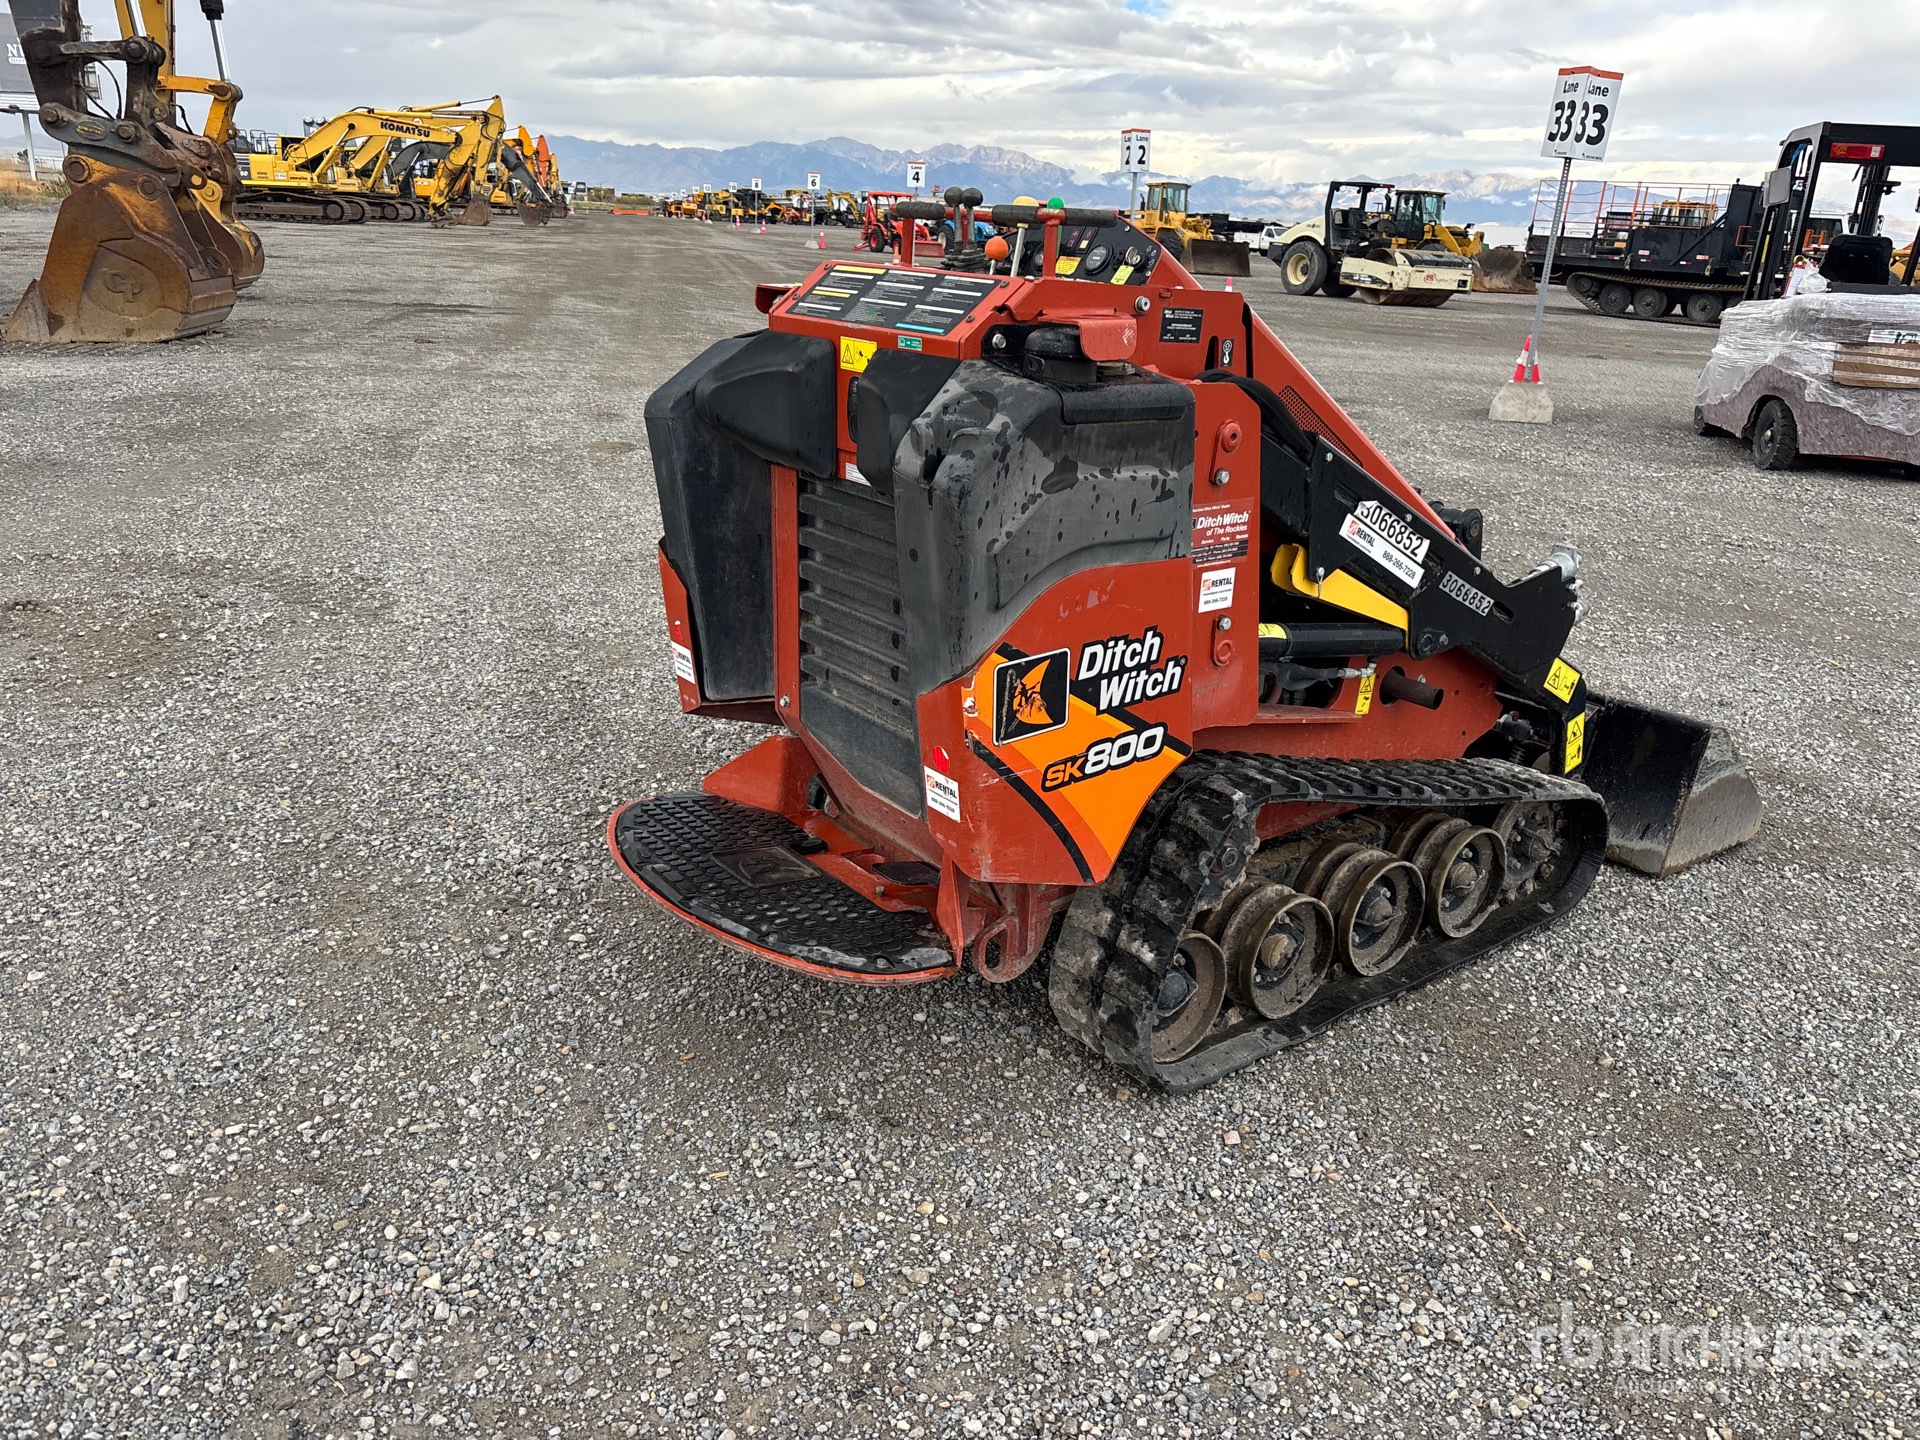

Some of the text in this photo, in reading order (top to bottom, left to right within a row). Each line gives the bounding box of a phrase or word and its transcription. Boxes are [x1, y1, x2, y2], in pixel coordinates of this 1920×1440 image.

[1563, 80, 1579, 94] Lane
[1587, 80, 1609, 97] Lane
[380, 121, 431, 138] KOMATSU
[1547, 99, 1577, 142] 33
[1574, 100, 1609, 146] 33
[1136, 134, 1149, 142] Lane
[1137, 144, 1146, 165] 2
[754, 181, 759, 189] 8
[811, 178, 817, 187] 6
[912, 171, 920, 183] 4
[1197, 515, 1222, 529] Ditch
[1206, 525, 1248, 536] of The Rockies
[1360, 504, 1424, 558] 3066852
[1355, 527, 1376, 548] RENTAL
[1382, 550, 1417, 580] 888-266-7228
[1211, 577, 1232, 588] RENTAL
[1441, 574, 1492, 615] 3066852
[1078, 630, 1161, 681] Ditch
[1044, 726, 1165, 788] SK800
[935, 780, 958, 799] RENTAL
